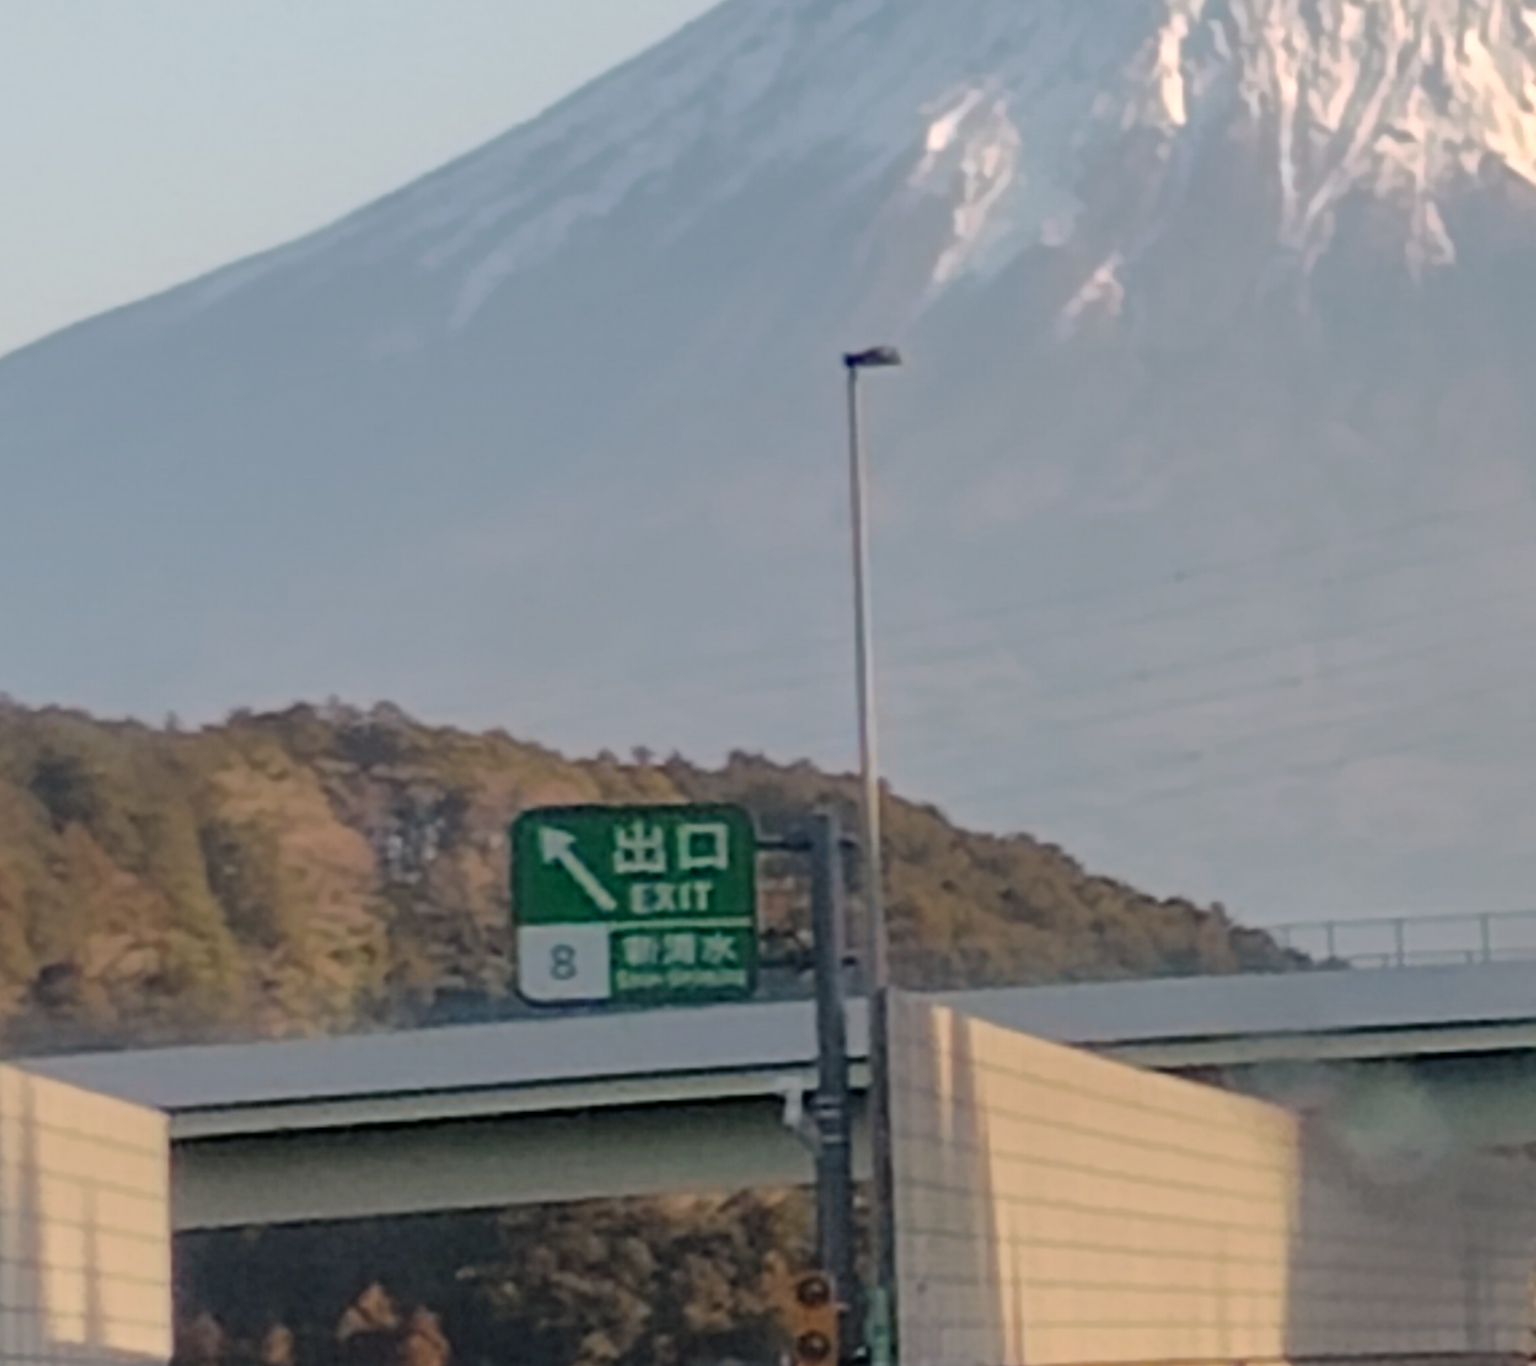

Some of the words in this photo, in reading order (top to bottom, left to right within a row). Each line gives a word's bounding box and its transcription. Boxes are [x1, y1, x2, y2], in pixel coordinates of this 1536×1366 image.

[613, 819, 728, 873] 出口
[630, 881, 713, 914] EXIT
[550, 944, 577, 981] 8
